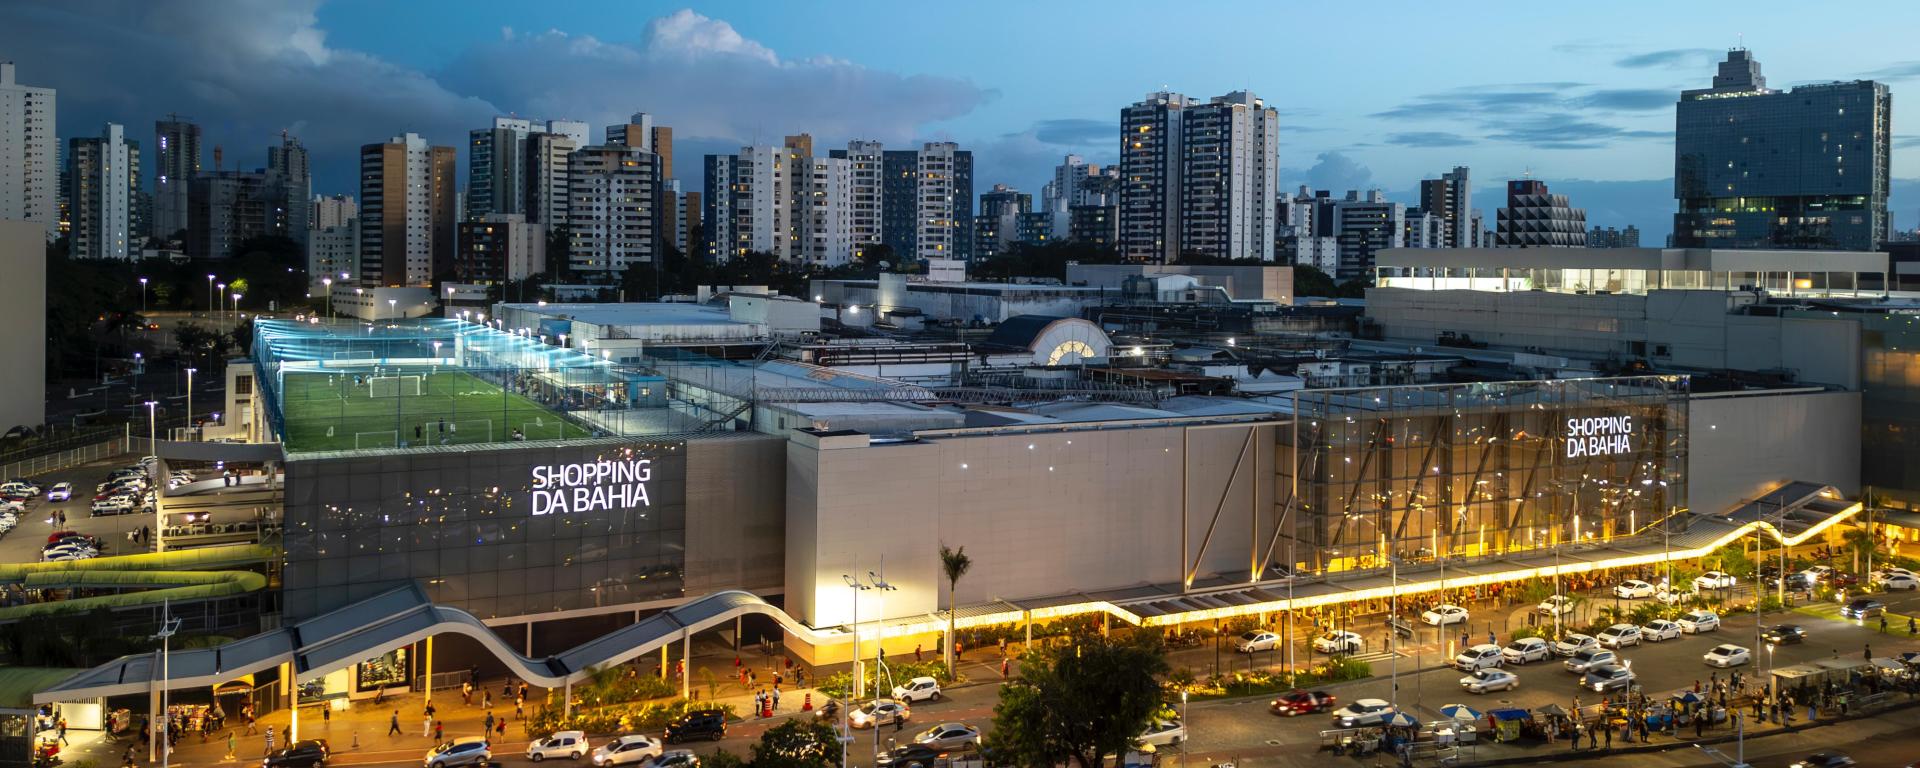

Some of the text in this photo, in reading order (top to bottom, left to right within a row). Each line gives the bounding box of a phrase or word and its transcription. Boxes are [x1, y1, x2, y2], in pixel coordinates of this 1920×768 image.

[1567, 415, 1632, 437] SHOPPING
[1567, 434, 1631, 458] DA BAHIA
[532, 459, 651, 489] SHOPPING
[532, 483, 650, 516] DA BAHIA
